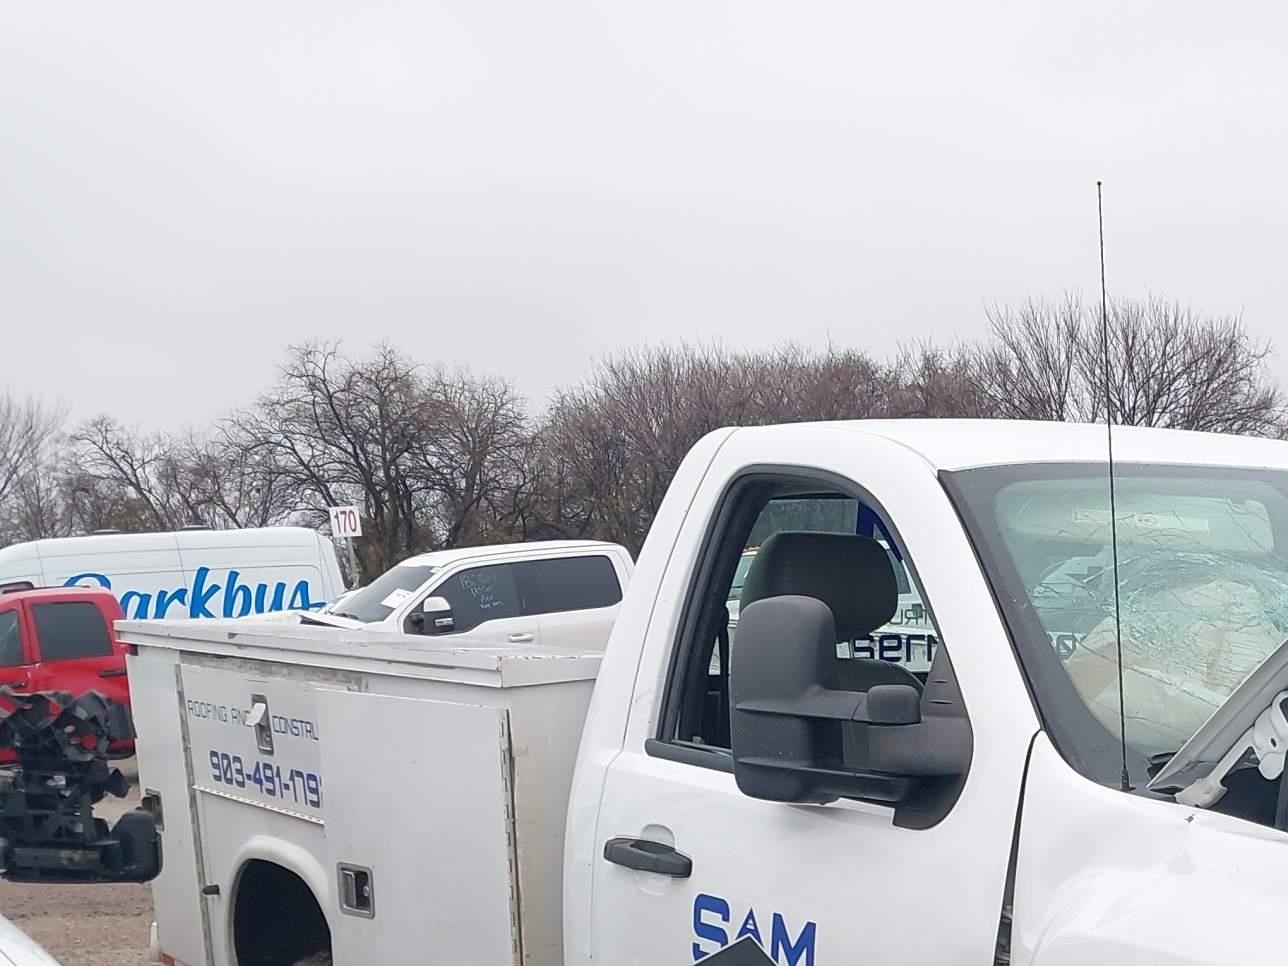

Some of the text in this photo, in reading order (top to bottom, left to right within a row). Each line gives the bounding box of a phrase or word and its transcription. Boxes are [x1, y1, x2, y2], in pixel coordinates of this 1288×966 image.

[334, 510, 357, 534] 170
[187, 700, 228, 723] ROOFING
[209, 750, 323, 809] 903-491-179
